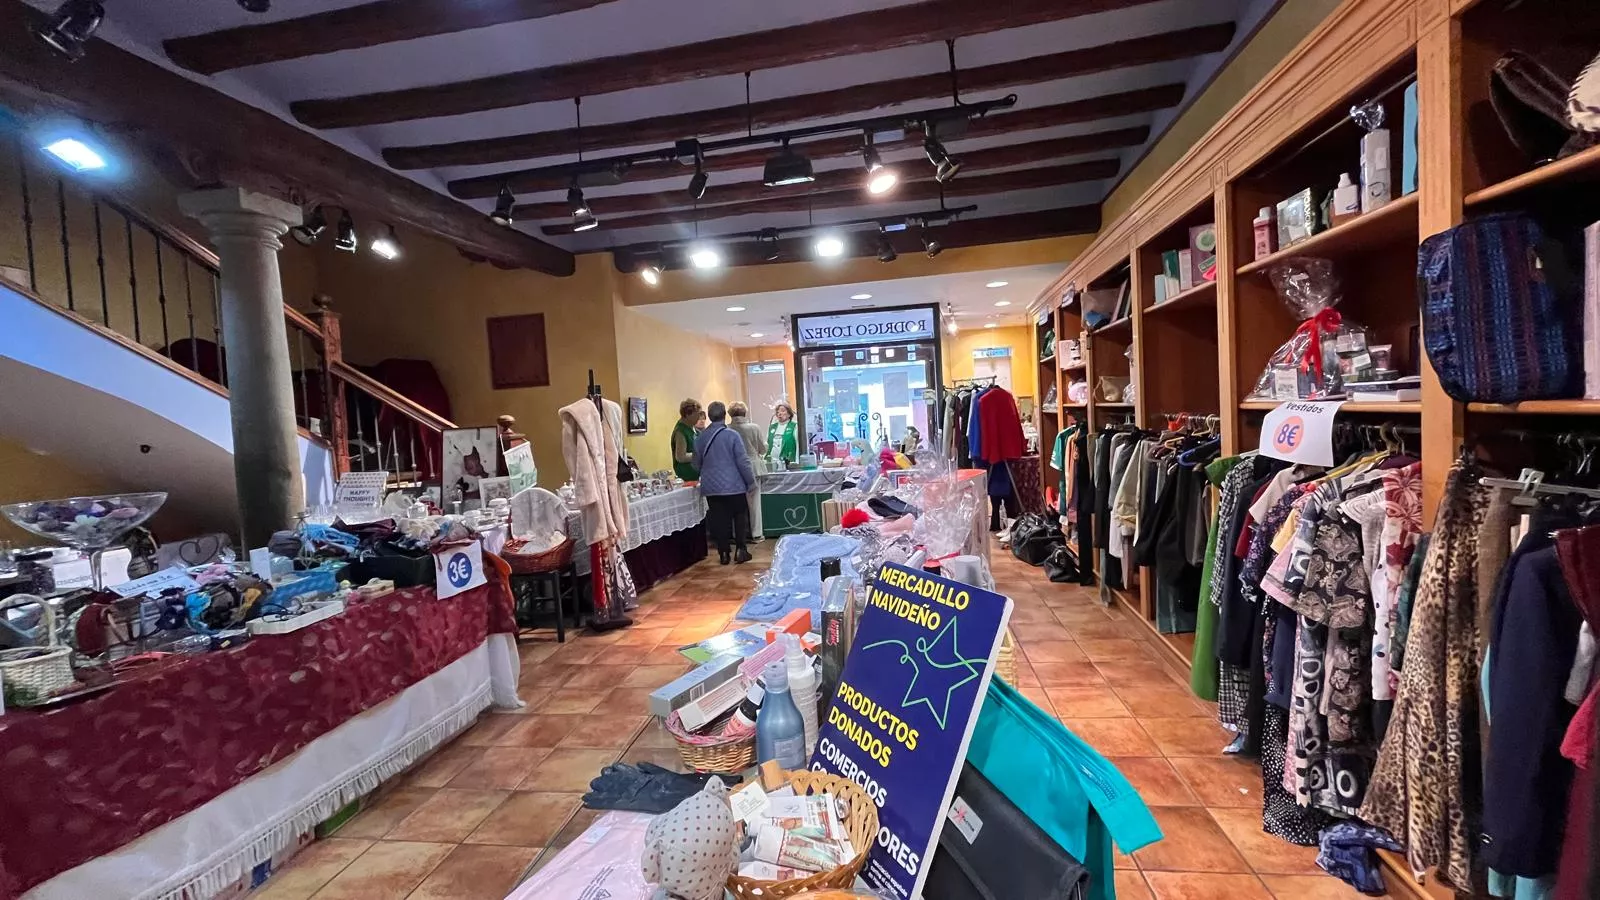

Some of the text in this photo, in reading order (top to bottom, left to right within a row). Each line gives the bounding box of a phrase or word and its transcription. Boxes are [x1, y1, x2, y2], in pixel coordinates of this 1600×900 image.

[1277, 423, 1300, 447] 8€
[449, 557, 469, 583] 3€
[878, 566, 970, 611] MERCADILLO
[870, 589, 941, 631] NAVIDEÑO
[828, 705, 892, 768] DONADOS
[837, 681, 920, 751] PRODUCTOS
[819, 737, 888, 808] COMERCIOS
